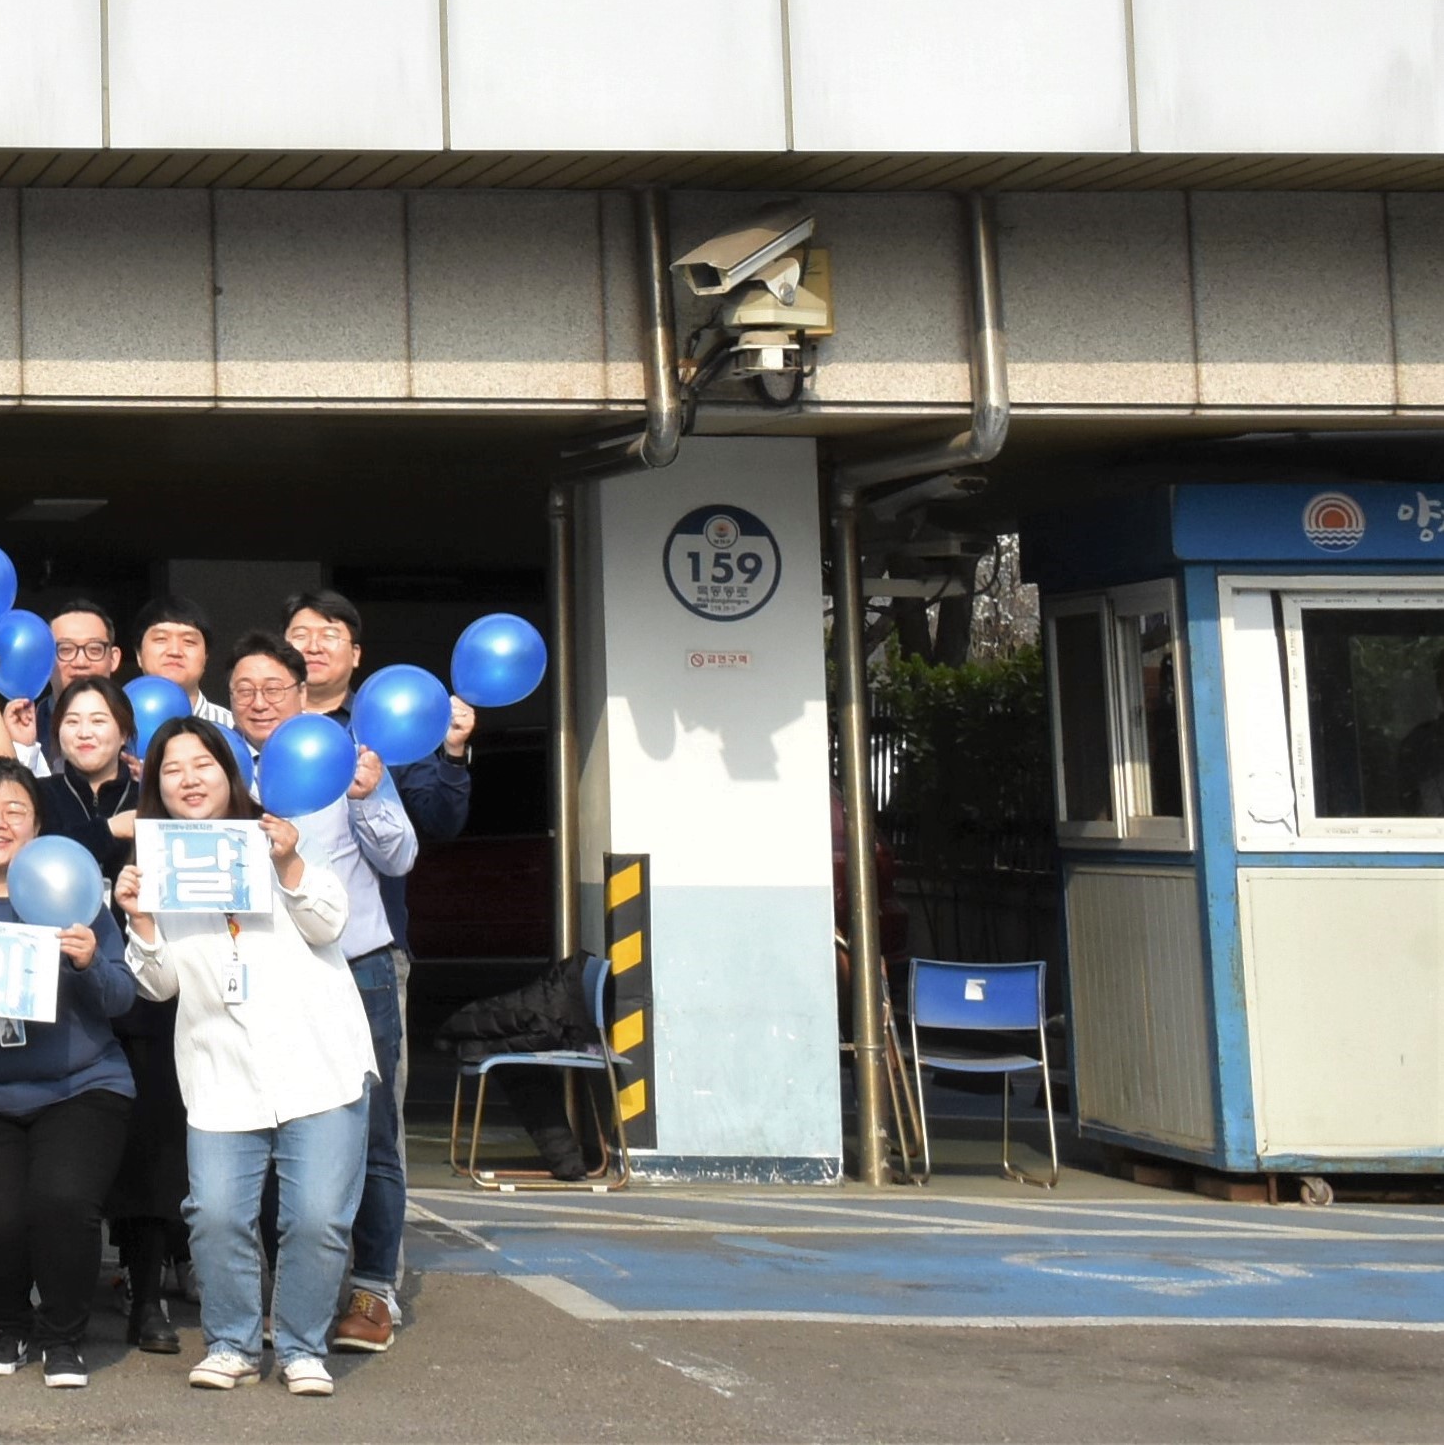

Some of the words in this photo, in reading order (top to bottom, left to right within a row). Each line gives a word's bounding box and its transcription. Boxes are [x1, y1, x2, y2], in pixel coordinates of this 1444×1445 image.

[1397, 490, 1444, 543] 양
[686, 551, 763, 585] 159
[171, 838, 239, 902] 날
